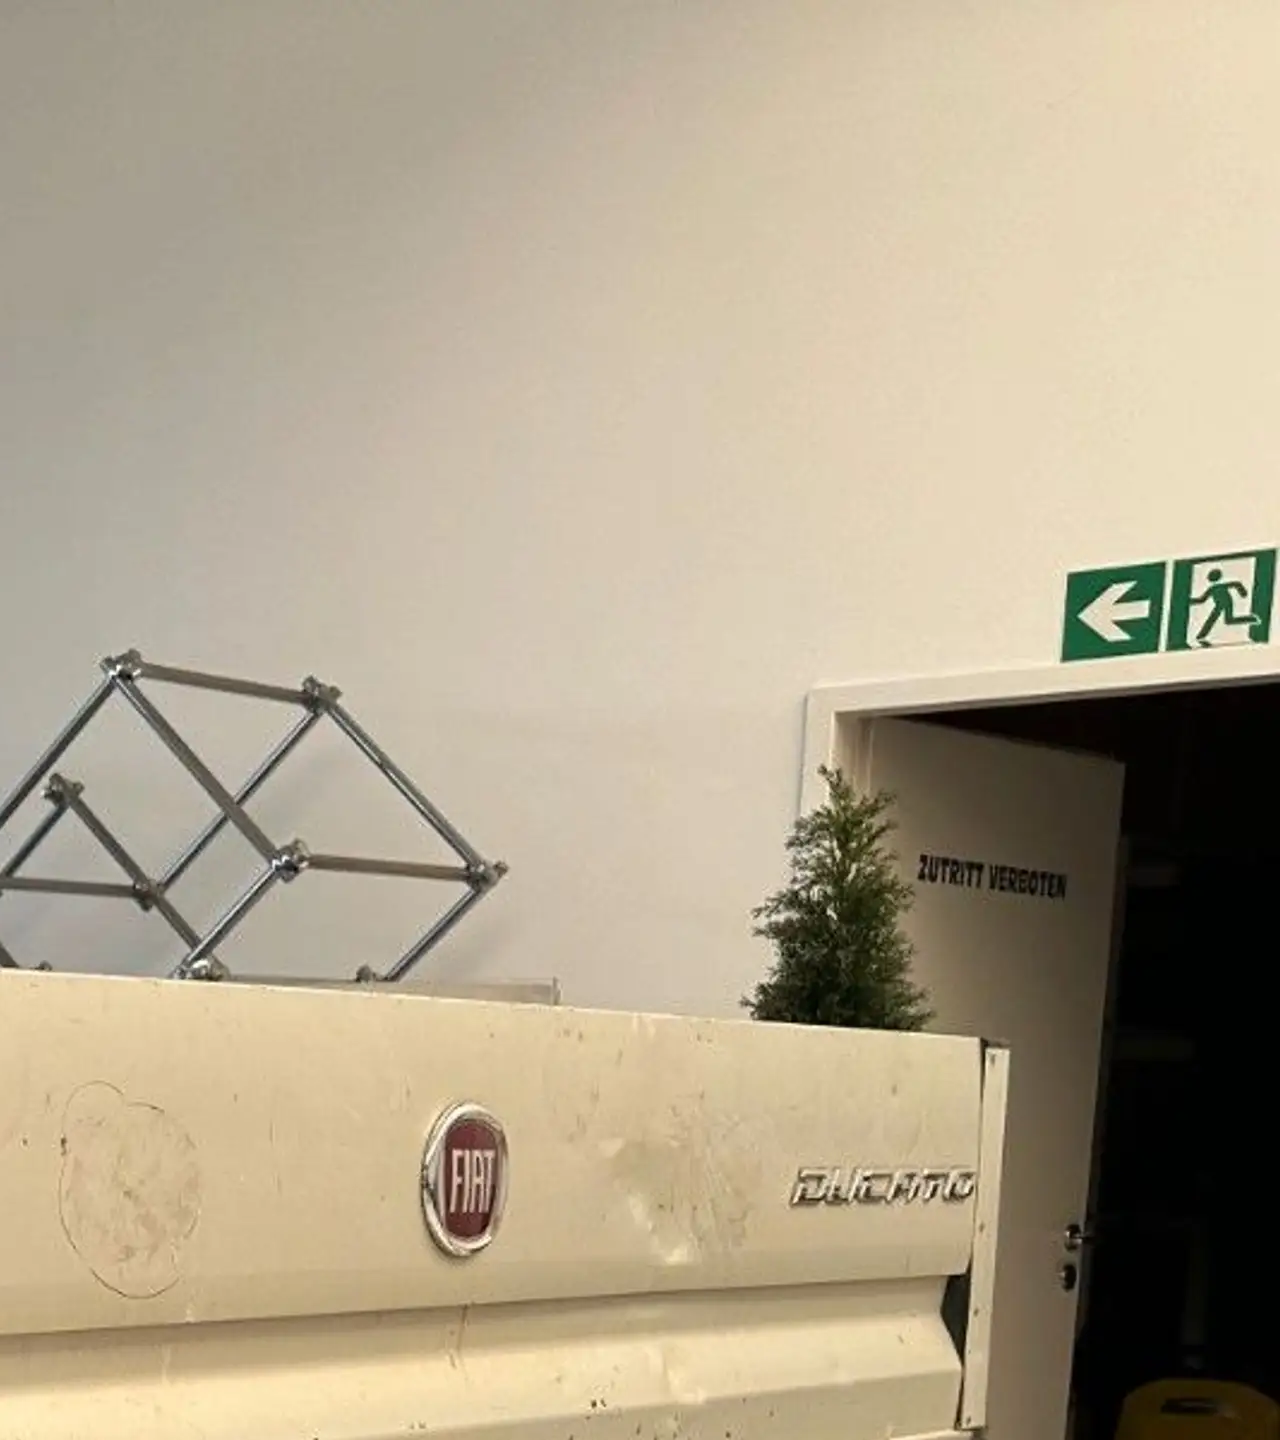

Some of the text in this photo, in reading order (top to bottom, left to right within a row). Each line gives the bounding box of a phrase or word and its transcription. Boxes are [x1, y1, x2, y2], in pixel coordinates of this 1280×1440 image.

[917, 854, 1067, 900] ZUTRITT VERBOTEN
[450, 1148, 496, 1213] FIAT
[791, 1166, 977, 1206] DUCATO
